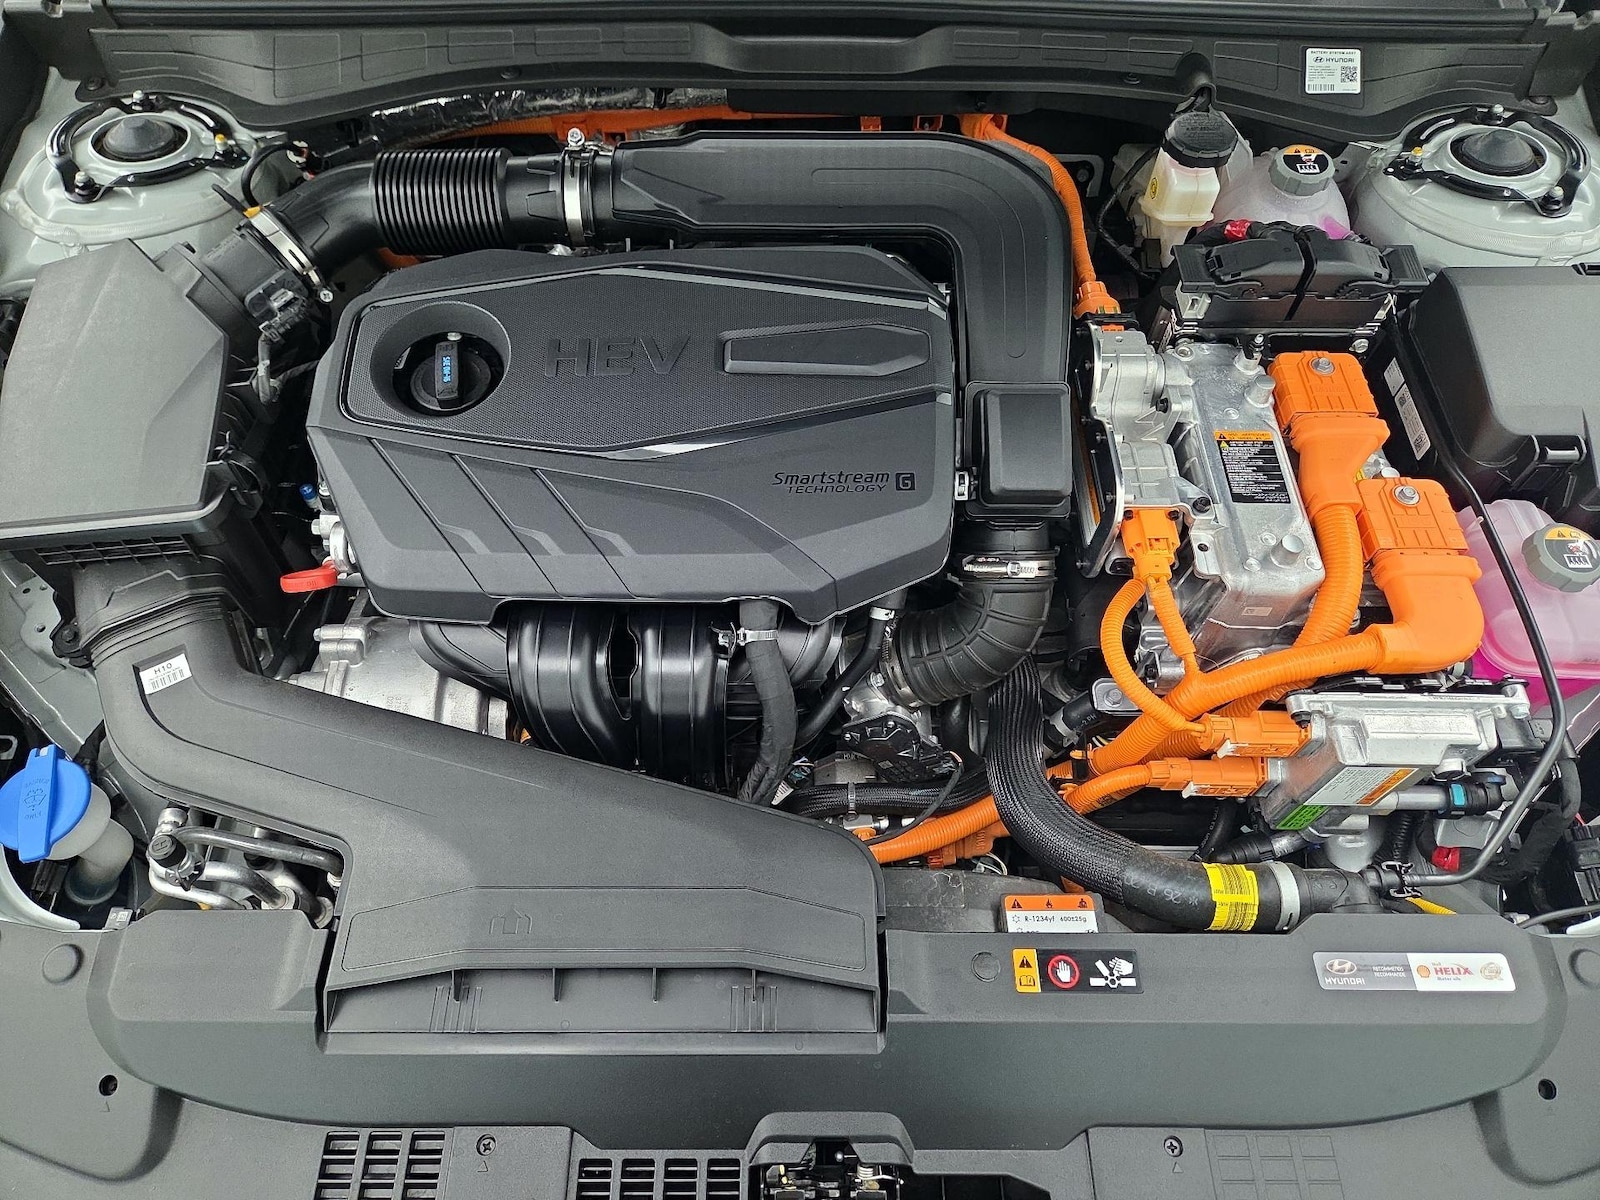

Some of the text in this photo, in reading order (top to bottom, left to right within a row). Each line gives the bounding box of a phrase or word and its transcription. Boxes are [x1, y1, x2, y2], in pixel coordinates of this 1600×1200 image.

[544, 335, 691, 377] HEV
[772, 471, 913, 490] Smartstream G
[788, 485, 887, 494] TECHNOLOGY
[153, 662, 173, 675] H10
[1024, 915, 1055, 923] R-1234yf
[1434, 967, 1474, 976] HELIX
[1324, 977, 1365, 985] HYUNDAI
